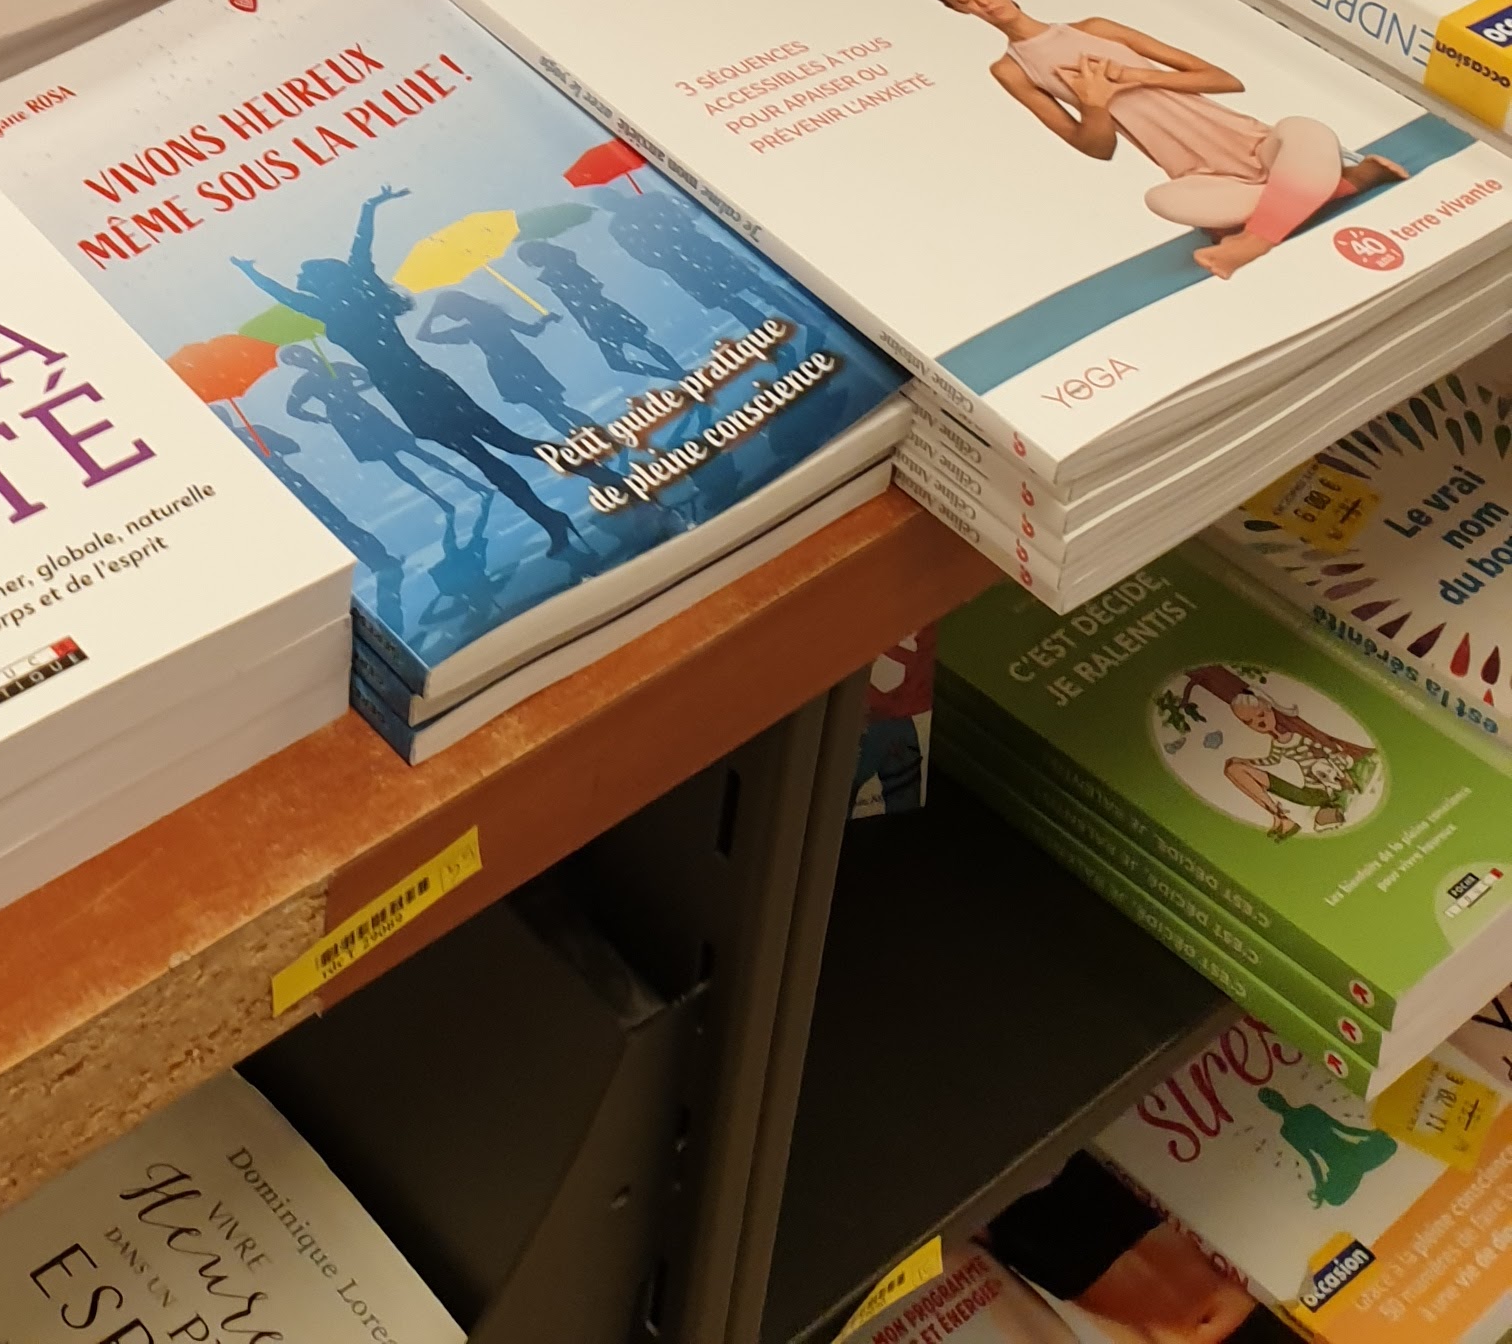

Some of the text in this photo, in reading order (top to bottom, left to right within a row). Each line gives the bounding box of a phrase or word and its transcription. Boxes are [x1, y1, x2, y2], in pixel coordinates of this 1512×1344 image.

[26, 85, 77, 116] ROSA
[84, 42, 386, 204] VIVONS HEUREUX
[77, 62, 459, 270] MÊME SOUS LA PLUIE
[1389, 174, 1503, 243] terre vivante
[36, 524, 124, 584] globale,
[125, 480, 217, 536] naturelle
[1382, 465, 1486, 540] Le vrai
[1441, 497, 1512, 551] nom
[1046, 600, 1189, 708] JE RALENTIS
[205, 1199, 274, 1274] VIVRE
[225, 1145, 341, 1280] Dominique
